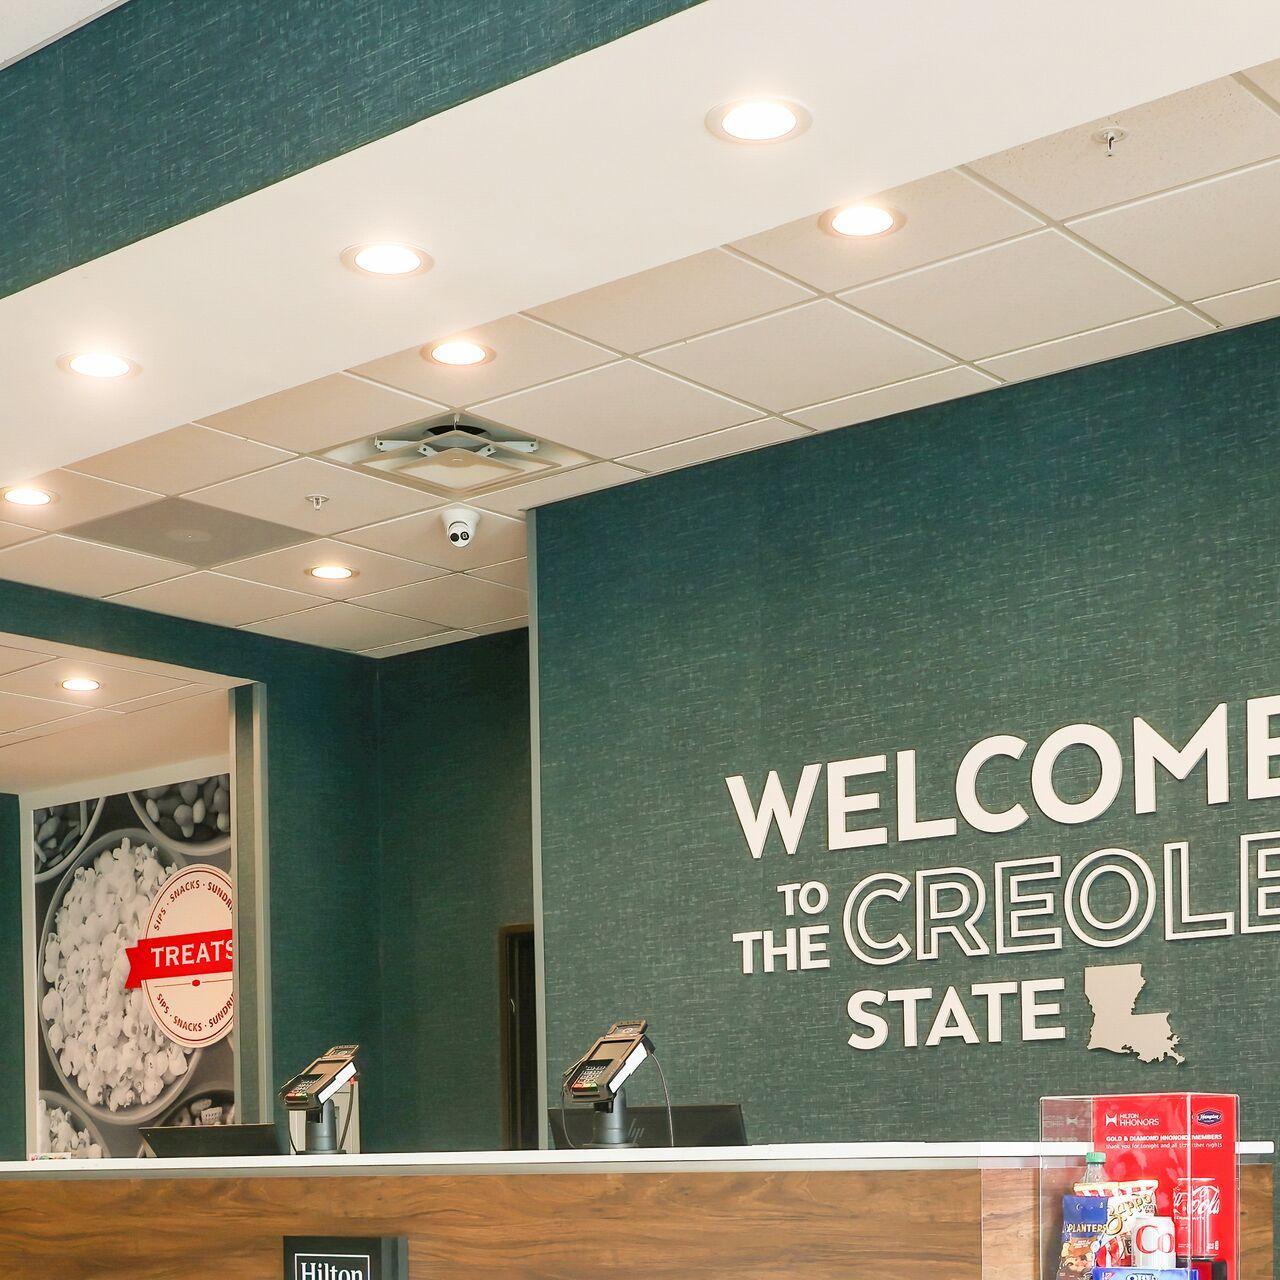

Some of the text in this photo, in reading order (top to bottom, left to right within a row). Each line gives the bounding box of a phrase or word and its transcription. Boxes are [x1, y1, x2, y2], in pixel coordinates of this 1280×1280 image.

[153, 907, 167, 931] SIPS
[169, 879, 200, 903] SNACKS
[776, 880, 829, 917] TO
[732, 924, 831, 975] THE
[156, 992, 234, 1032] SIPS SNACKS SUNDRI
[846, 976, 1066, 1051] STATE
[1119, 1118, 1160, 1127] HHONORS
[1129, 1134, 1160, 1142] DIAMOND
[1191, 1133, 1223, 1141] MEMBERS
[1067, 1222, 1108, 1233] PLANTERS
